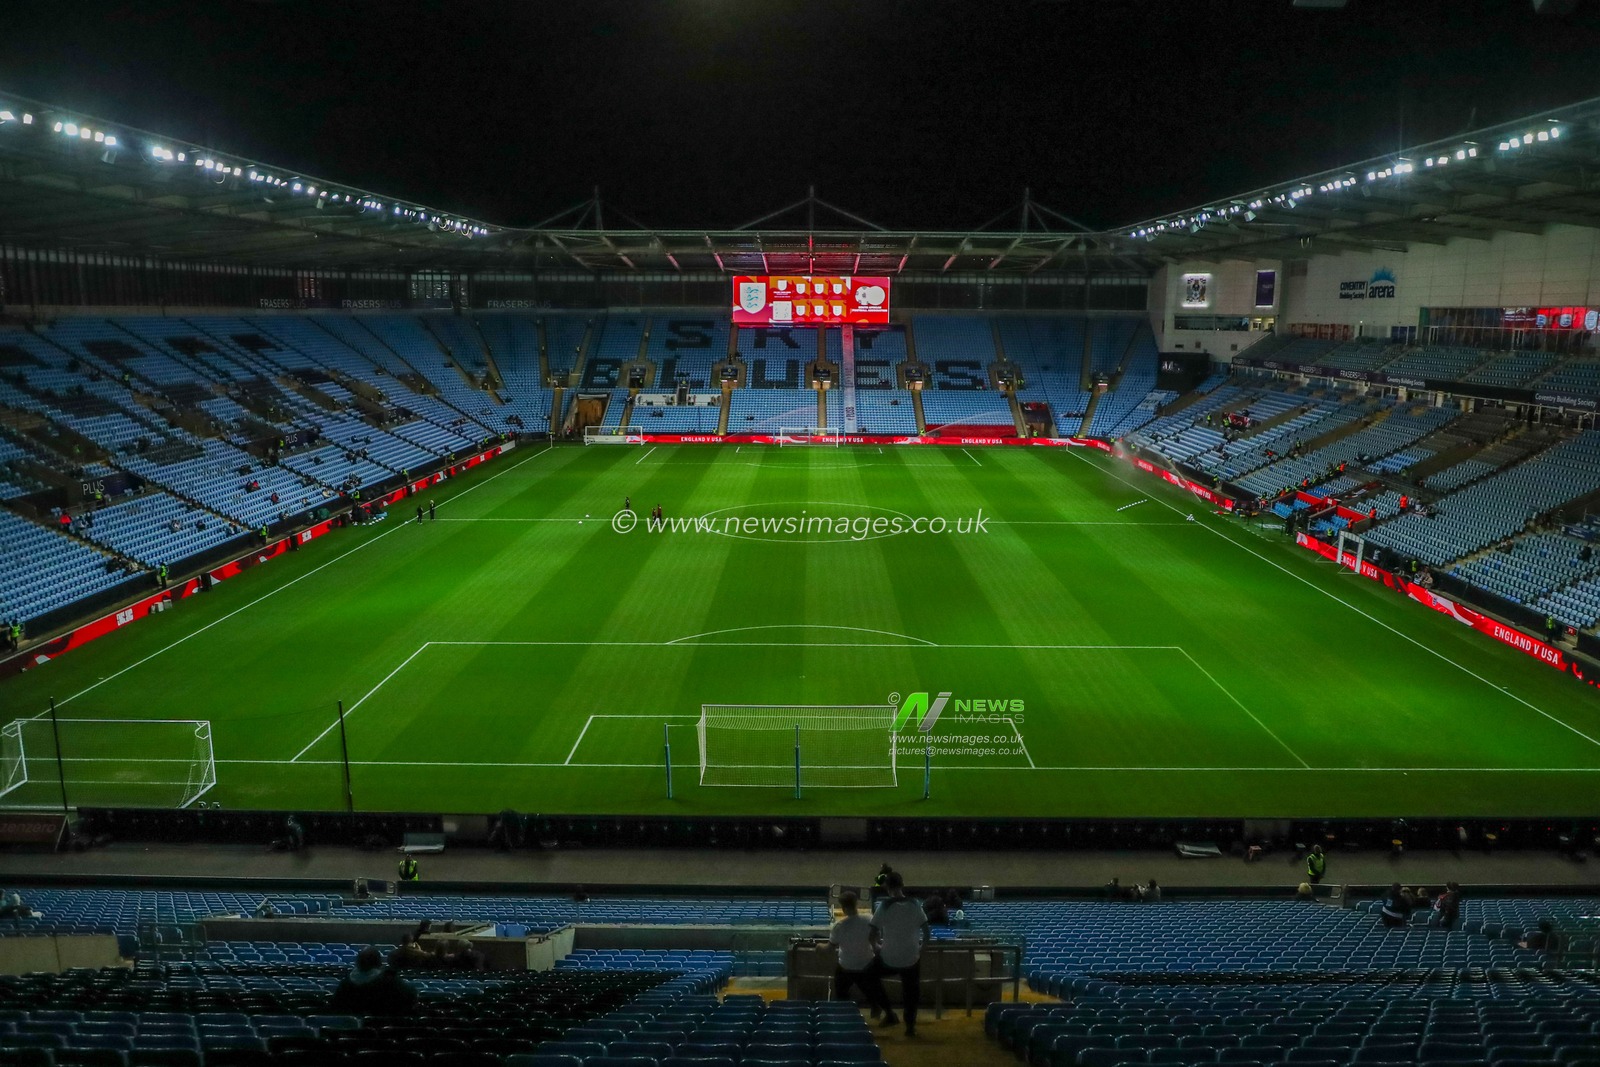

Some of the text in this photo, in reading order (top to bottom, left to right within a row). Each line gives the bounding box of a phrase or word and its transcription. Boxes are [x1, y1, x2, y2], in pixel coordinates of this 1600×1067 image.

[1369, 285, 1394, 298] arena
[1535, 393, 1597, 408] Coventry Building Society
[1362, 564, 1367, 573] V
[1367, 566, 1378, 579] USA
[1494, 625, 1559, 665] ENGLAND V USA
